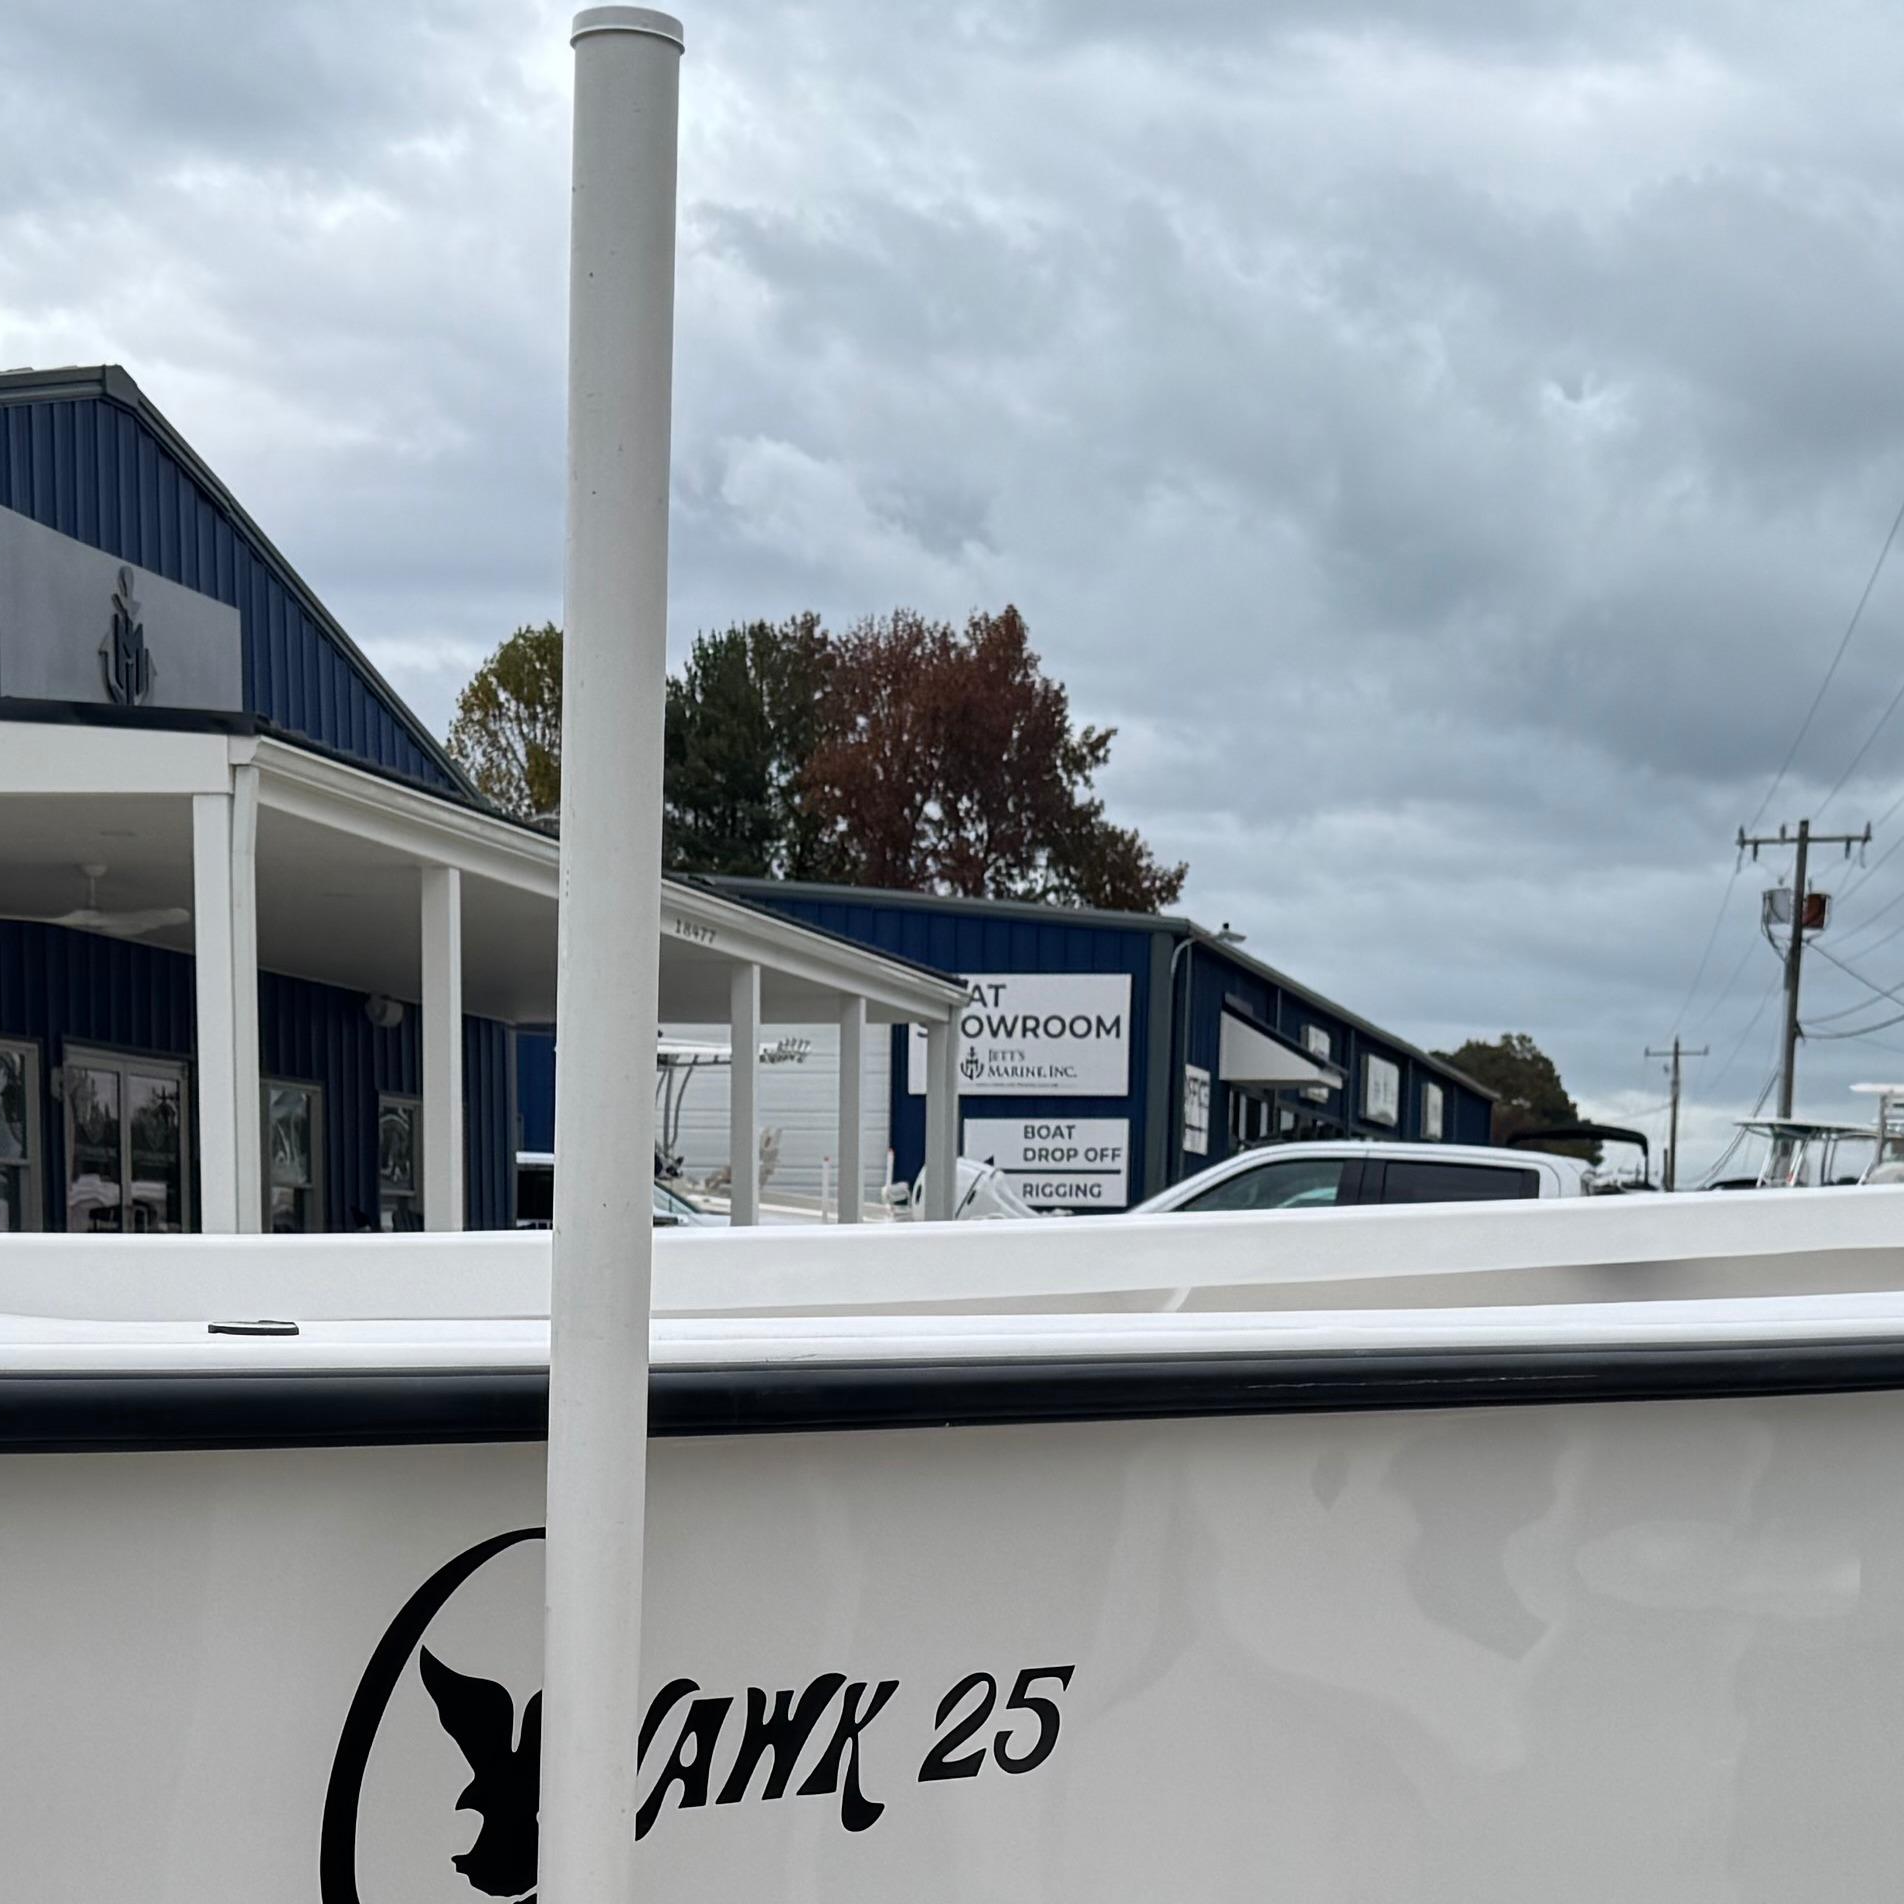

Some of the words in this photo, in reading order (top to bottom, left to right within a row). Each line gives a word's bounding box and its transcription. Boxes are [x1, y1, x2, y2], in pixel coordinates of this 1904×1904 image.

[968, 983, 1007, 1009] AT
[917, 1013, 1122, 1040] OWROOM
[1023, 1124, 1077, 1140] BOAT
[1022, 1147, 1079, 1163] DROP
[1084, 1147, 1122, 1163] OFF
[1022, 1183, 1103, 1199] RIGGING
[917, 1664, 1077, 1784] 25
